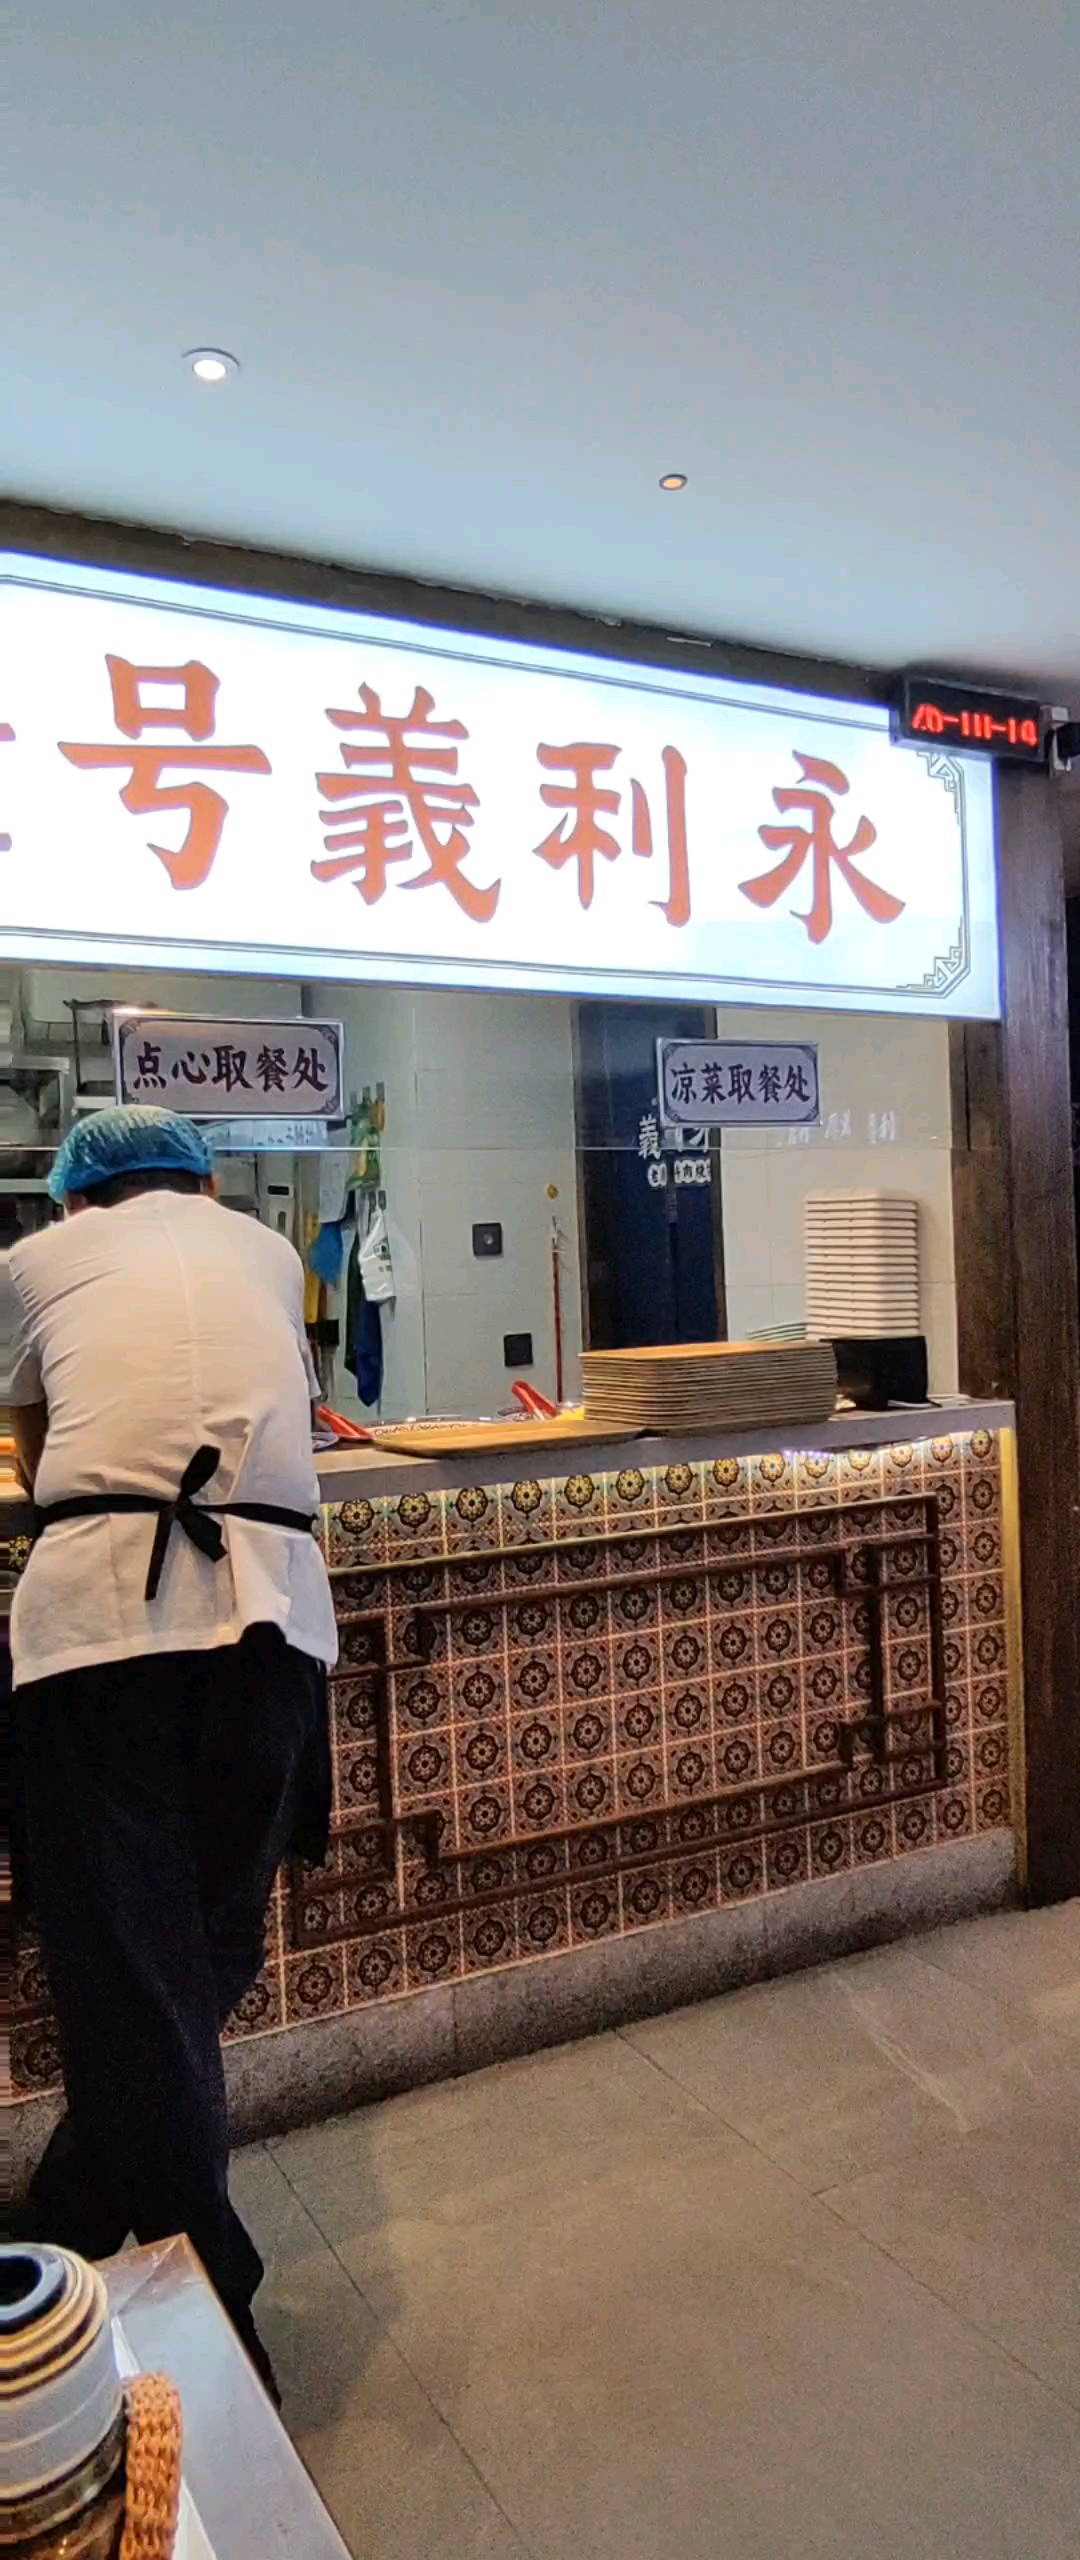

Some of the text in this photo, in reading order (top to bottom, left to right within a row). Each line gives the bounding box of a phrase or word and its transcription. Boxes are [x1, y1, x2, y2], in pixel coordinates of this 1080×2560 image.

[132, 1040, 329, 1093] 点心取餐处
[671, 1061, 811, 1105] 凉菜取餐处
